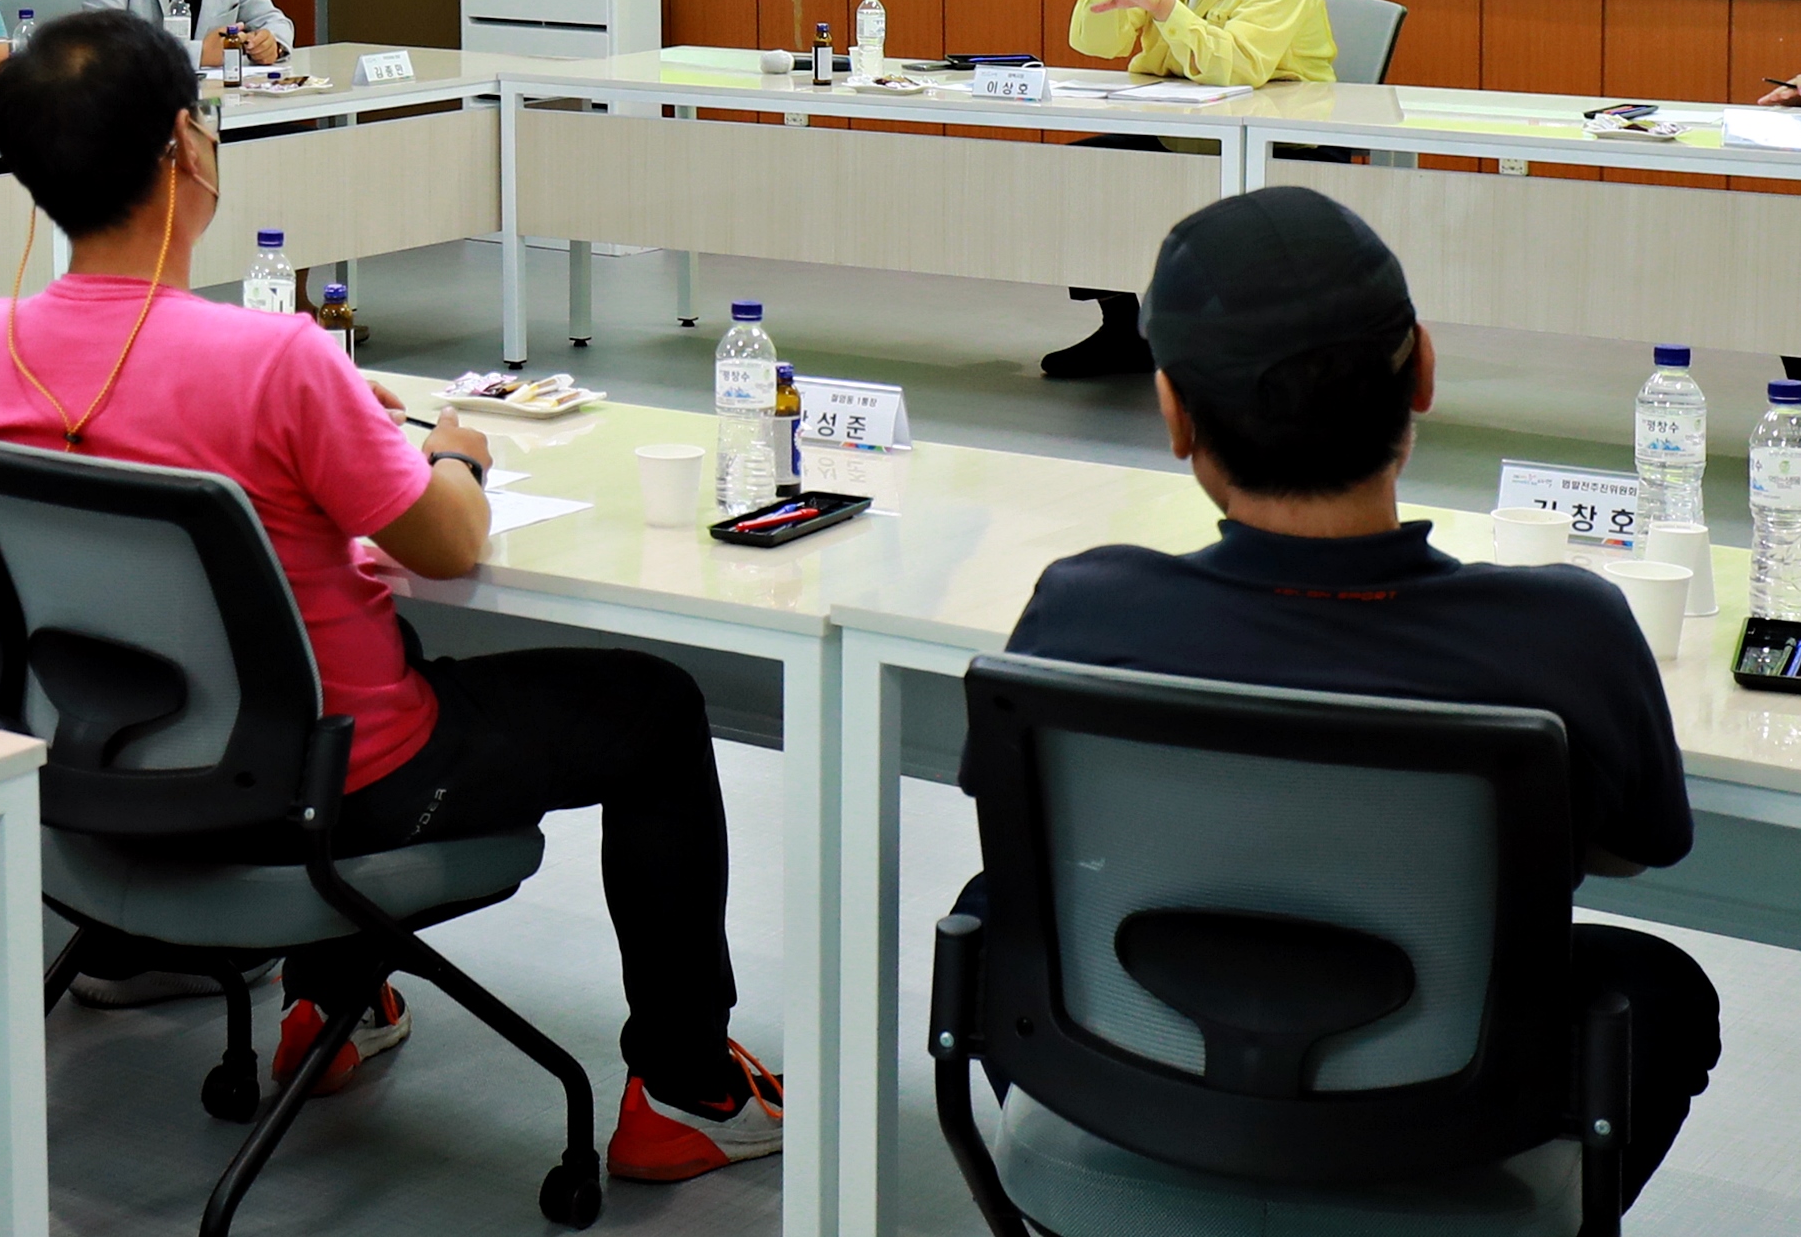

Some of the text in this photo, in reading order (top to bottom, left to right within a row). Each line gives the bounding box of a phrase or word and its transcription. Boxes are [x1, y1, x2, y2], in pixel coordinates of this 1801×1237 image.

[987, 81, 1028, 96] 이상호
[830, 393, 853, 405] 철암동
[802, 410, 866, 441] 성준
[1647, 419, 1679, 434] 평창수
